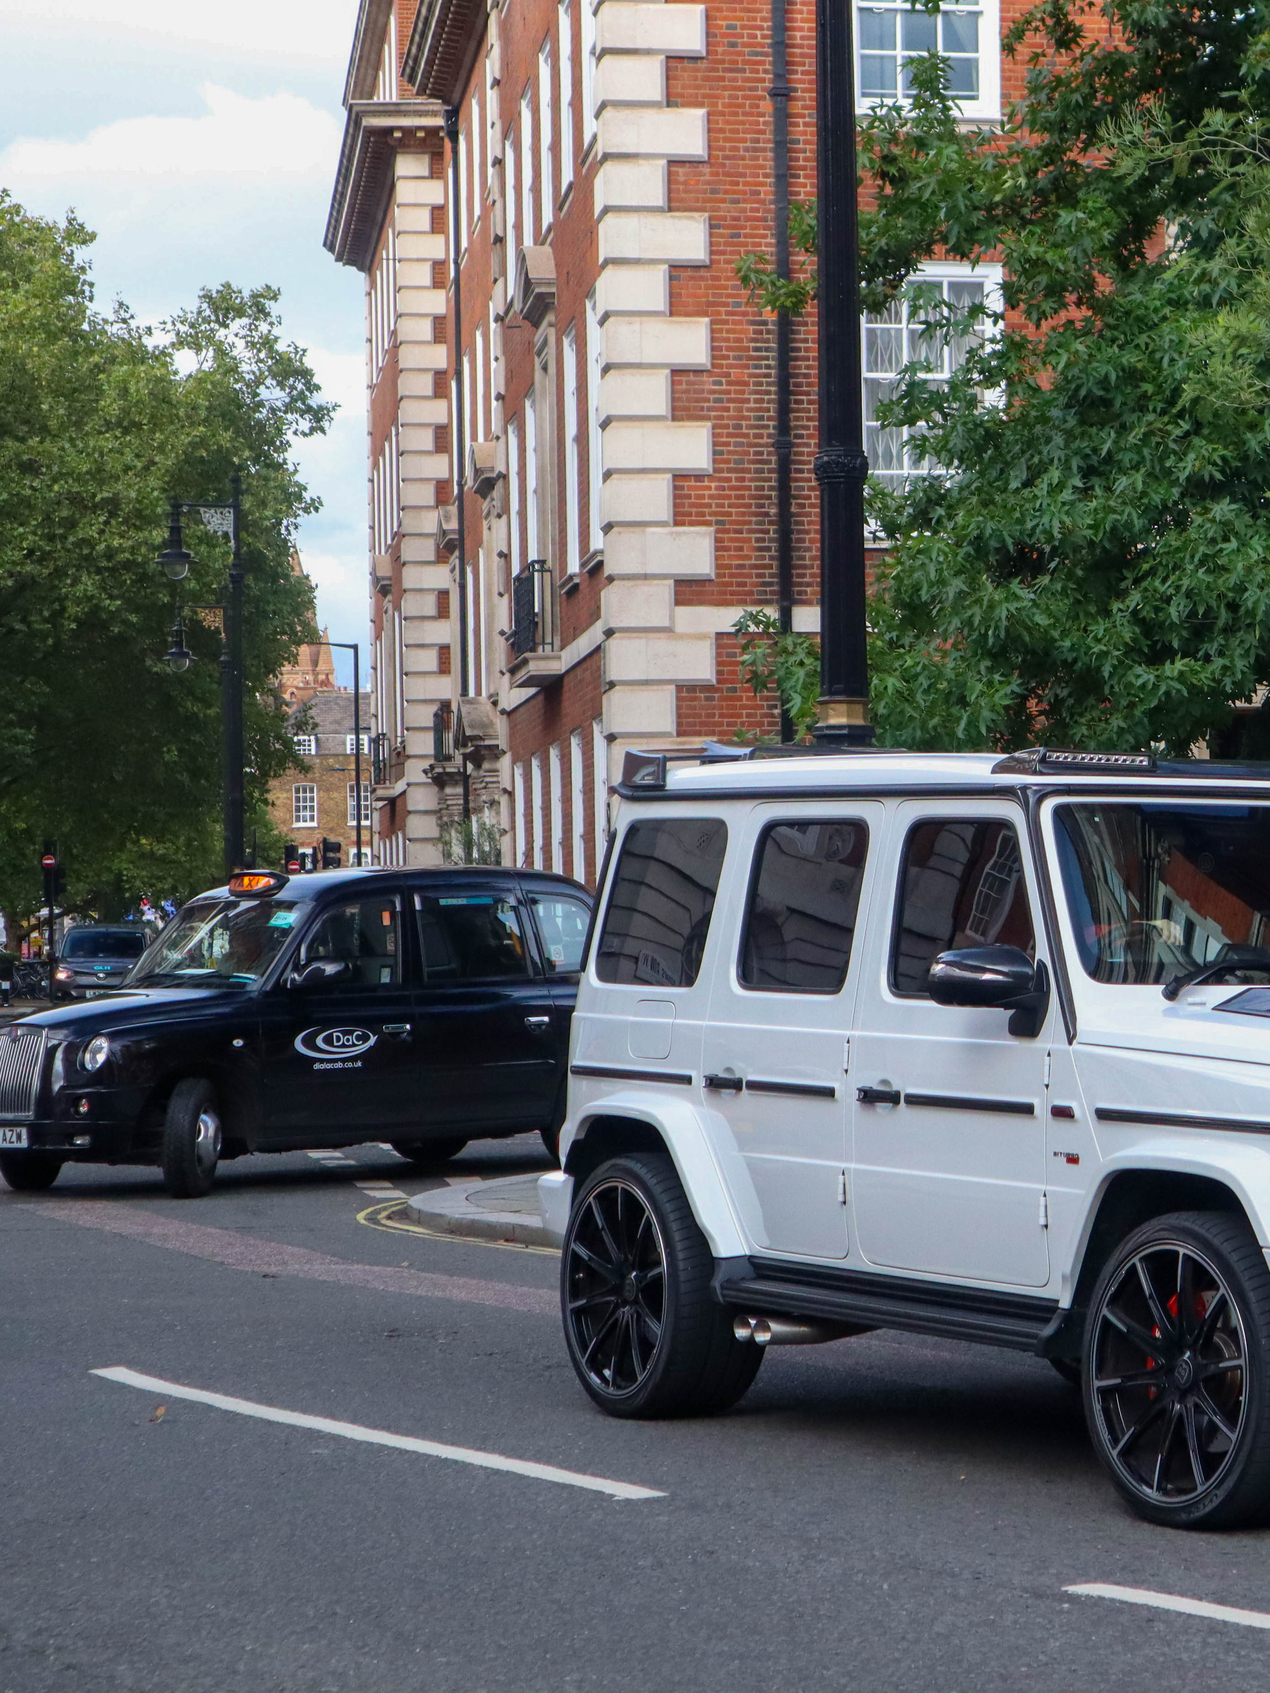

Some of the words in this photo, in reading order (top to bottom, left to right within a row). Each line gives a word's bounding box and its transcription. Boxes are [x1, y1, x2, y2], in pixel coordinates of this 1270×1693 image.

[333, 1031, 363, 1046] DaC
[313, 1060, 362, 1070] dialacab.co.uk
[1, 1129, 22, 1144] AZW
